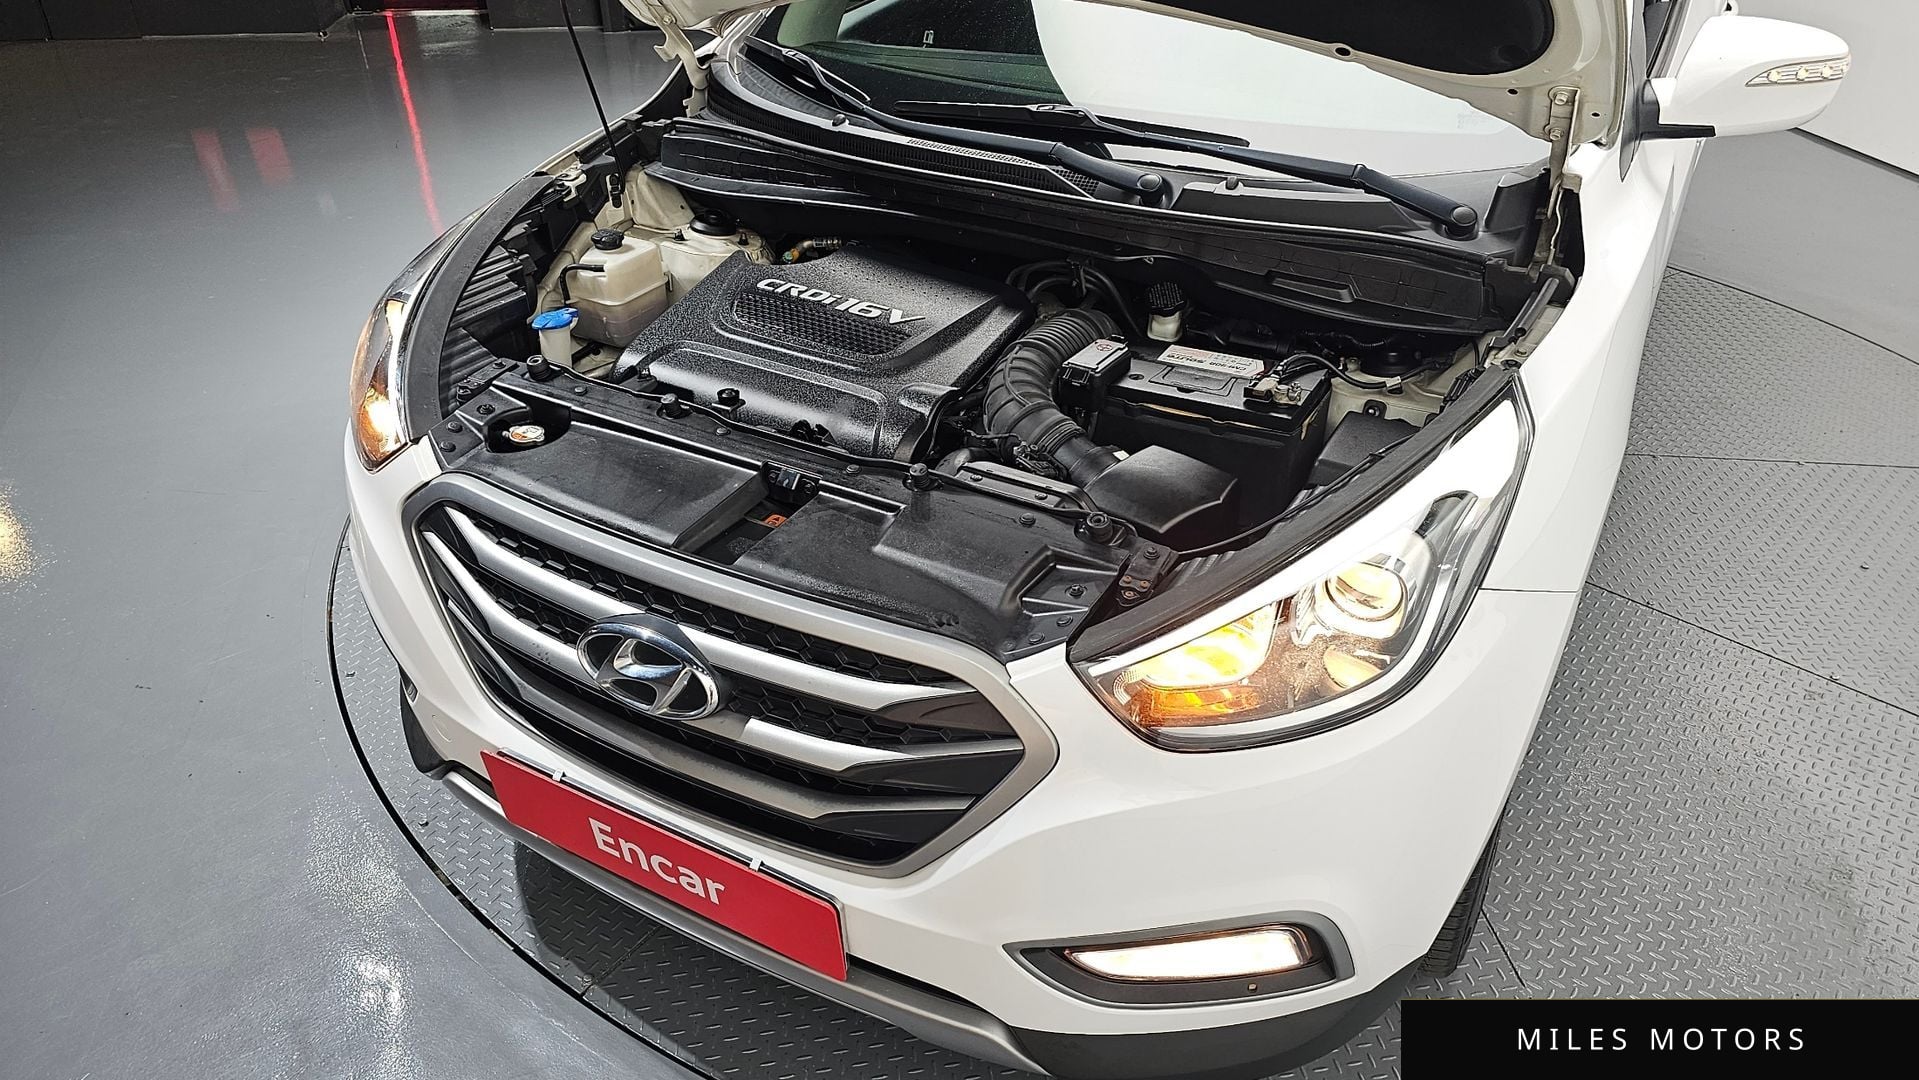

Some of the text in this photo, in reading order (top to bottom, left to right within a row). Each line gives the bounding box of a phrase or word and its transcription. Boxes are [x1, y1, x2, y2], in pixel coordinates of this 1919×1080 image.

[756, 278, 926, 325] CRDi 16V
[588, 816, 726, 905] Encar
